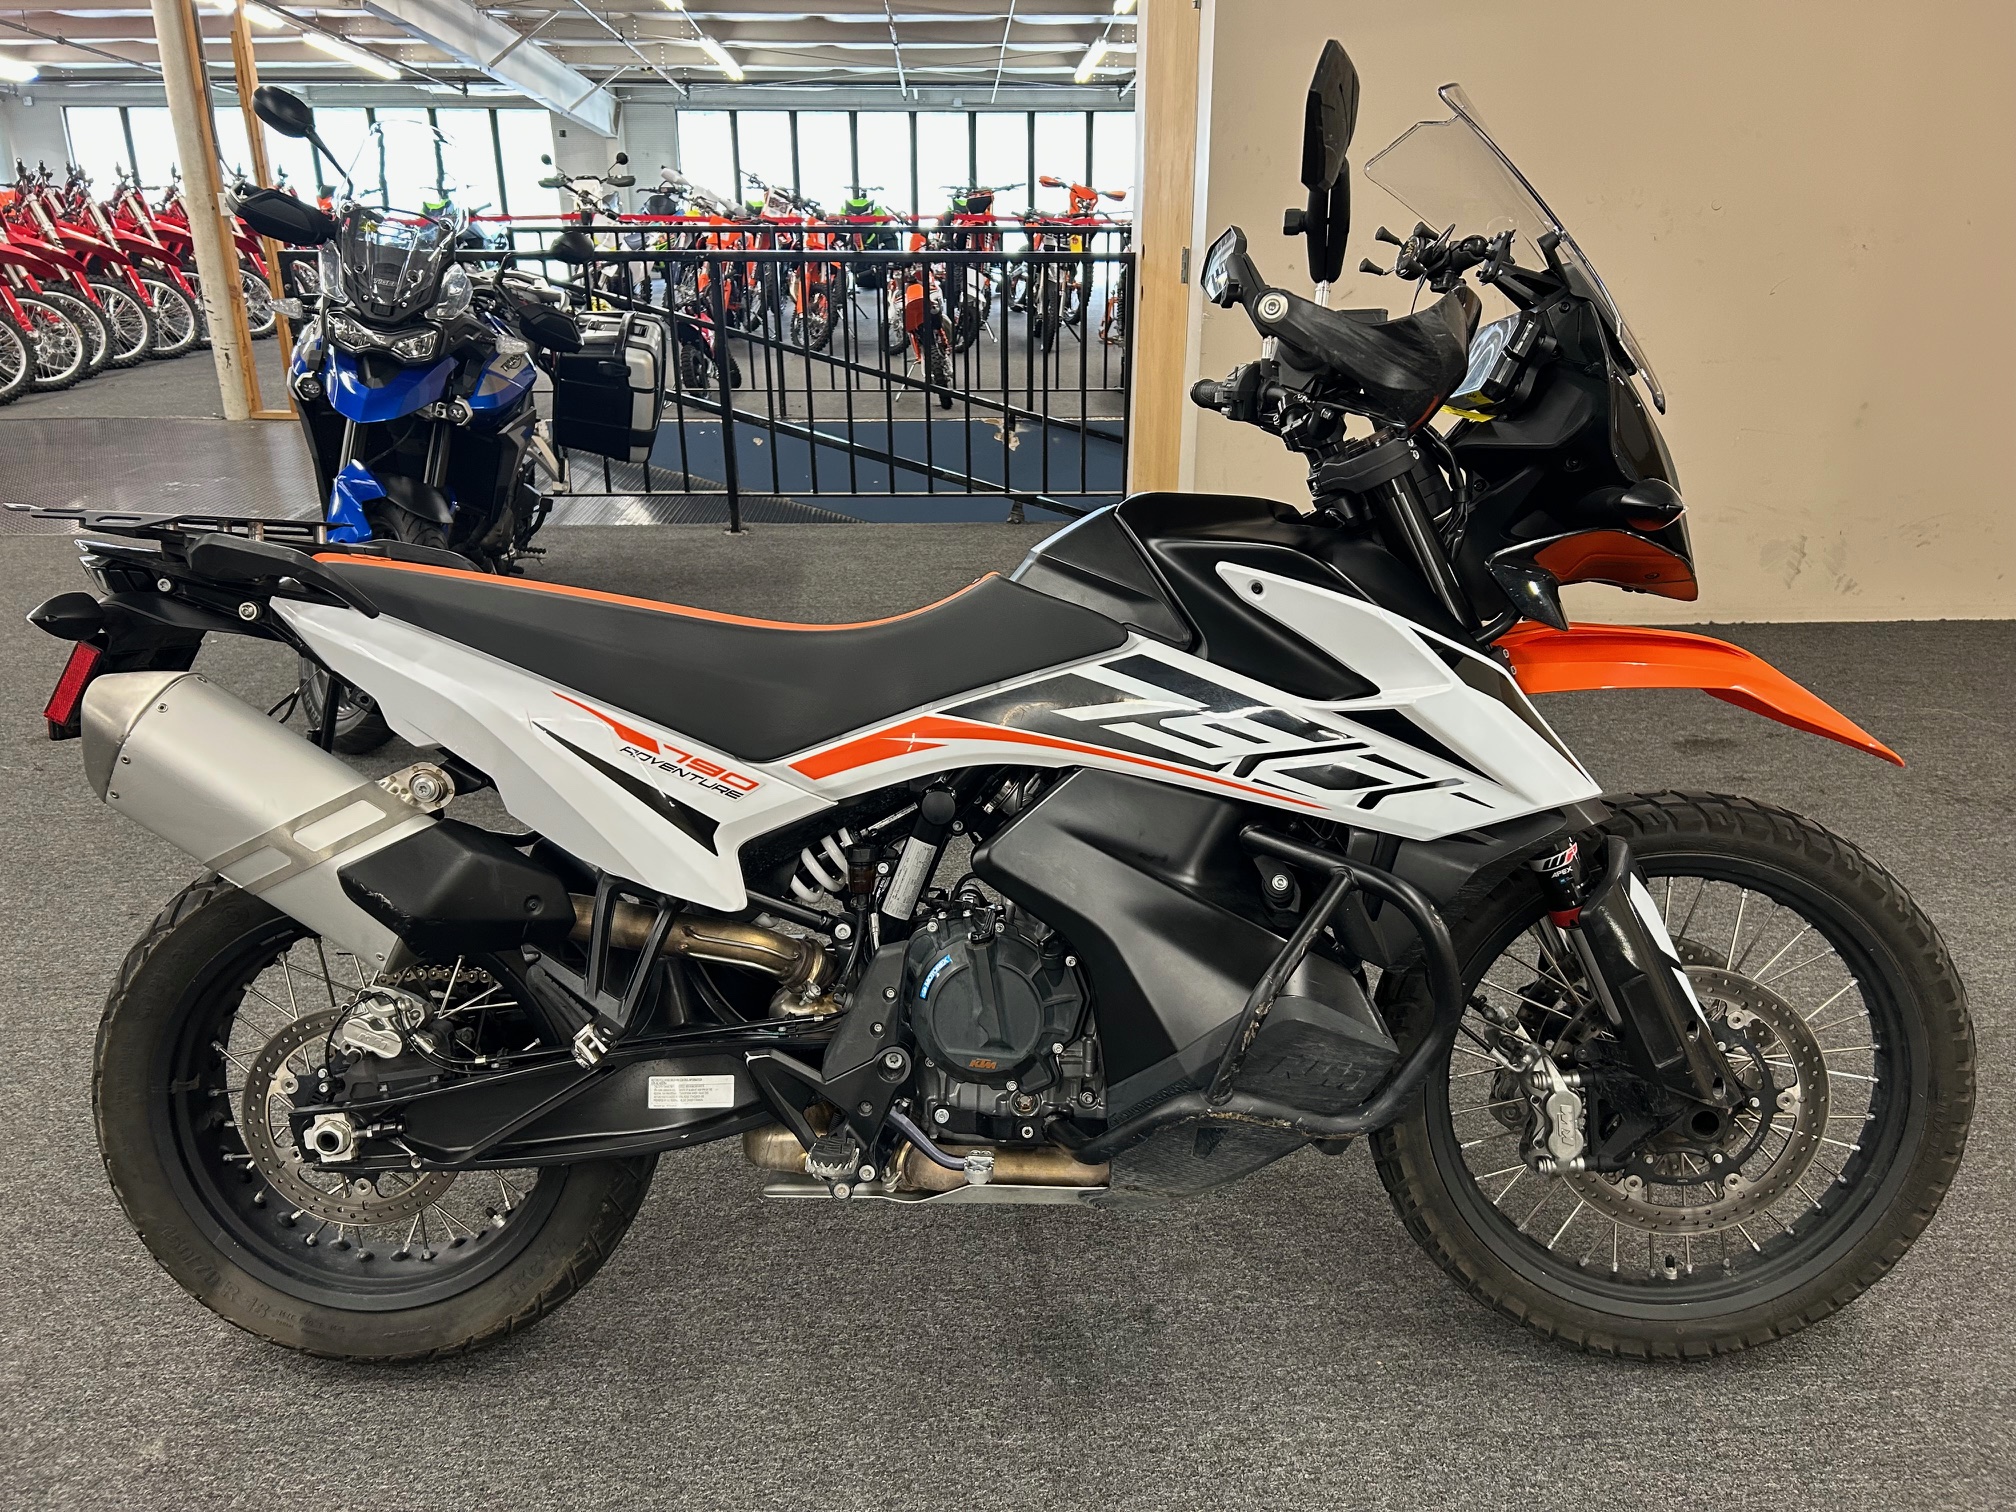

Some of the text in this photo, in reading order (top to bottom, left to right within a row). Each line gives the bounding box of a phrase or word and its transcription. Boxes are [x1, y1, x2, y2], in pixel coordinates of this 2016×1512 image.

[620, 746, 744, 799] ADVENTURE
[663, 744, 760, 791] 790
[969, 1058, 997, 1070] KTM
[1557, 1104, 1575, 1147] KTM
